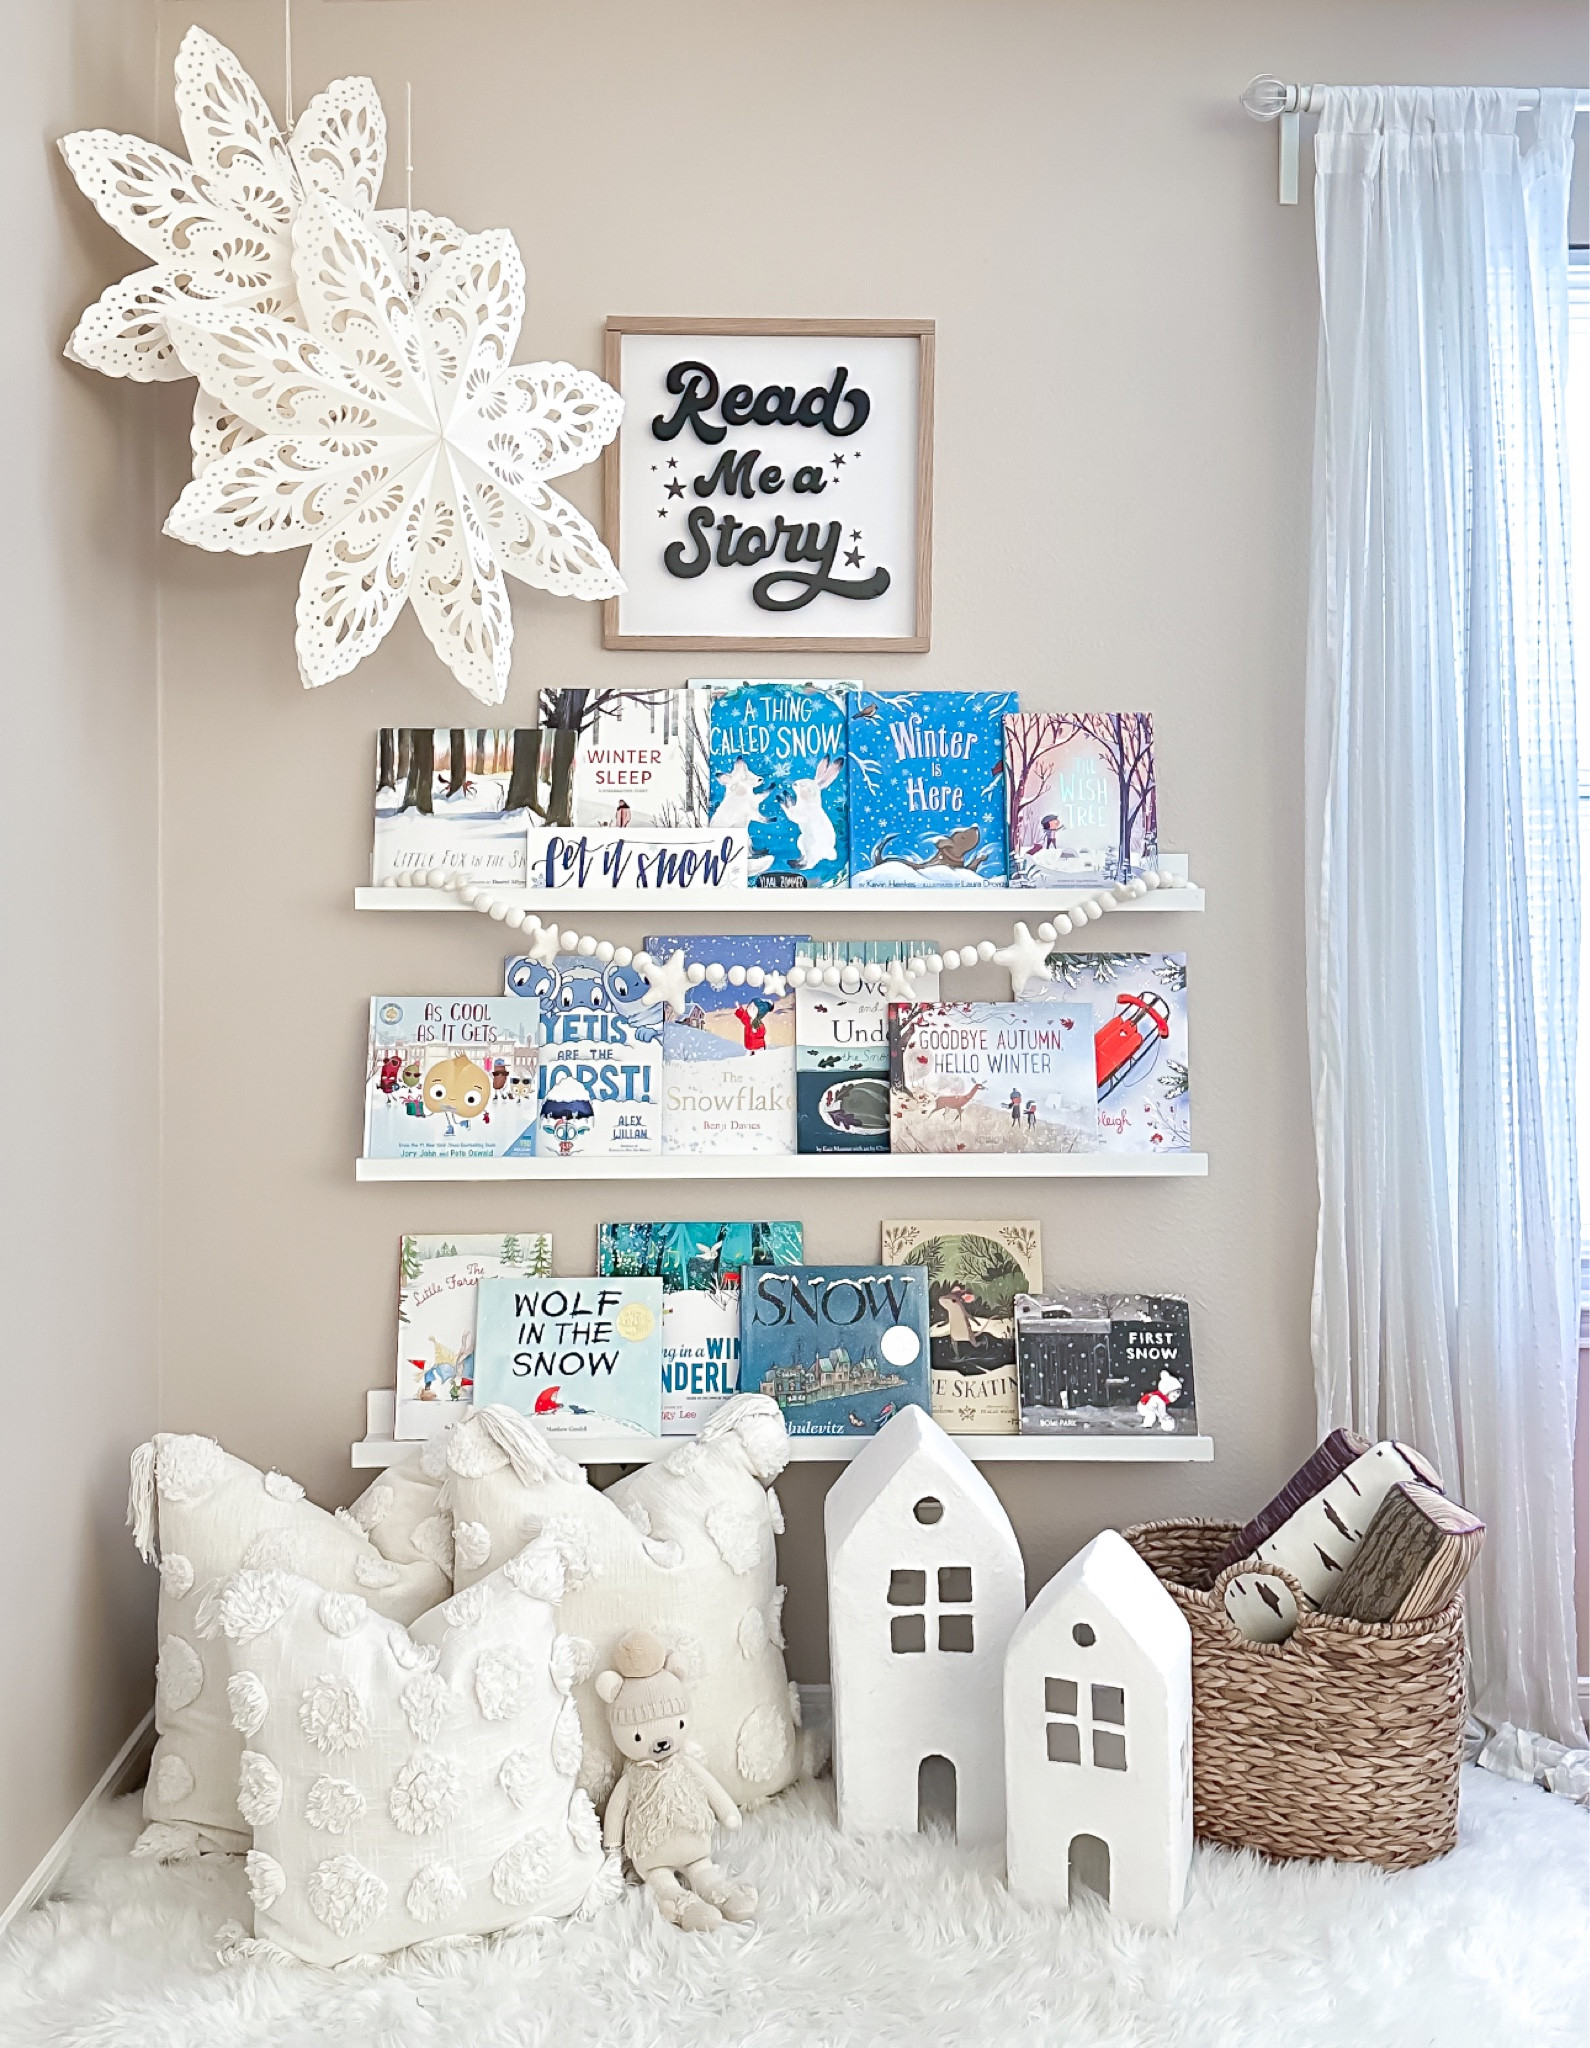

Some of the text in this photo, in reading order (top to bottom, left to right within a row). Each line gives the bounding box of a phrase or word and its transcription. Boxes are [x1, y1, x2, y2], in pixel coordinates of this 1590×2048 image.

[652, 361, 870, 445] Read
[694, 450, 828, 499] Me a
[664, 506, 891, 611] Story
[744, 696, 812, 723] A THING
[710, 723, 843, 759] CALLED SNOW
[889, 712, 979, 760] Winter
[587, 750, 662, 764] WINTER
[1074, 758, 1097, 775] THE
[595, 770, 652, 784] SLEEP
[1059, 772, 1108, 805] WISH
[906, 776, 963, 812] Here
[1064, 804, 1107, 829] TREE
[509, 850, 527, 869] SN
[838, 977, 887, 997] Ove
[450, 1002, 491, 1022] COOL
[441, 1023, 456, 1043] IT
[539, 1014, 630, 1044] YETIS
[832, 1019, 890, 1043] Und
[918, 1029, 1064, 1052] GOODBYE AUTUMN,
[557, 1049, 613, 1061] ARE THE
[934, 1053, 1051, 1074] HELLO WINTER
[721, 1071, 744, 1083] The
[618, 1115, 643, 1127] ALEX
[703, 1120, 761, 1131] Benji Davies
[1097, 1108, 1132, 1135] leigh
[400, 1149, 417, 1158] Jory
[420, 1149, 437, 1157] John
[450, 1149, 466, 1157] Pete
[468, 1149, 494, 1157] Oswald
[466, 1262, 485, 1274] The
[413, 1283, 443, 1306] Little
[514, 1290, 622, 1319] WOLF
[752, 1272, 916, 1327] SNOW
[518, 1321, 613, 1346] IN THE
[1128, 1331, 1174, 1345] FIRST
[679, 1344, 694, 1358] in
[695, 1347, 705, 1358] a
[706, 1337, 742, 1360] WIN
[1125, 1347, 1178, 1360] SNOW
[512, 1349, 620, 1377] SNOW
[661, 1361, 742, 1394] NDERL
[952, 1376, 1018, 1399] SKATIN
[785, 1420, 845, 1435] hulevitz
[1059, 1418, 1078, 1427] PARK
